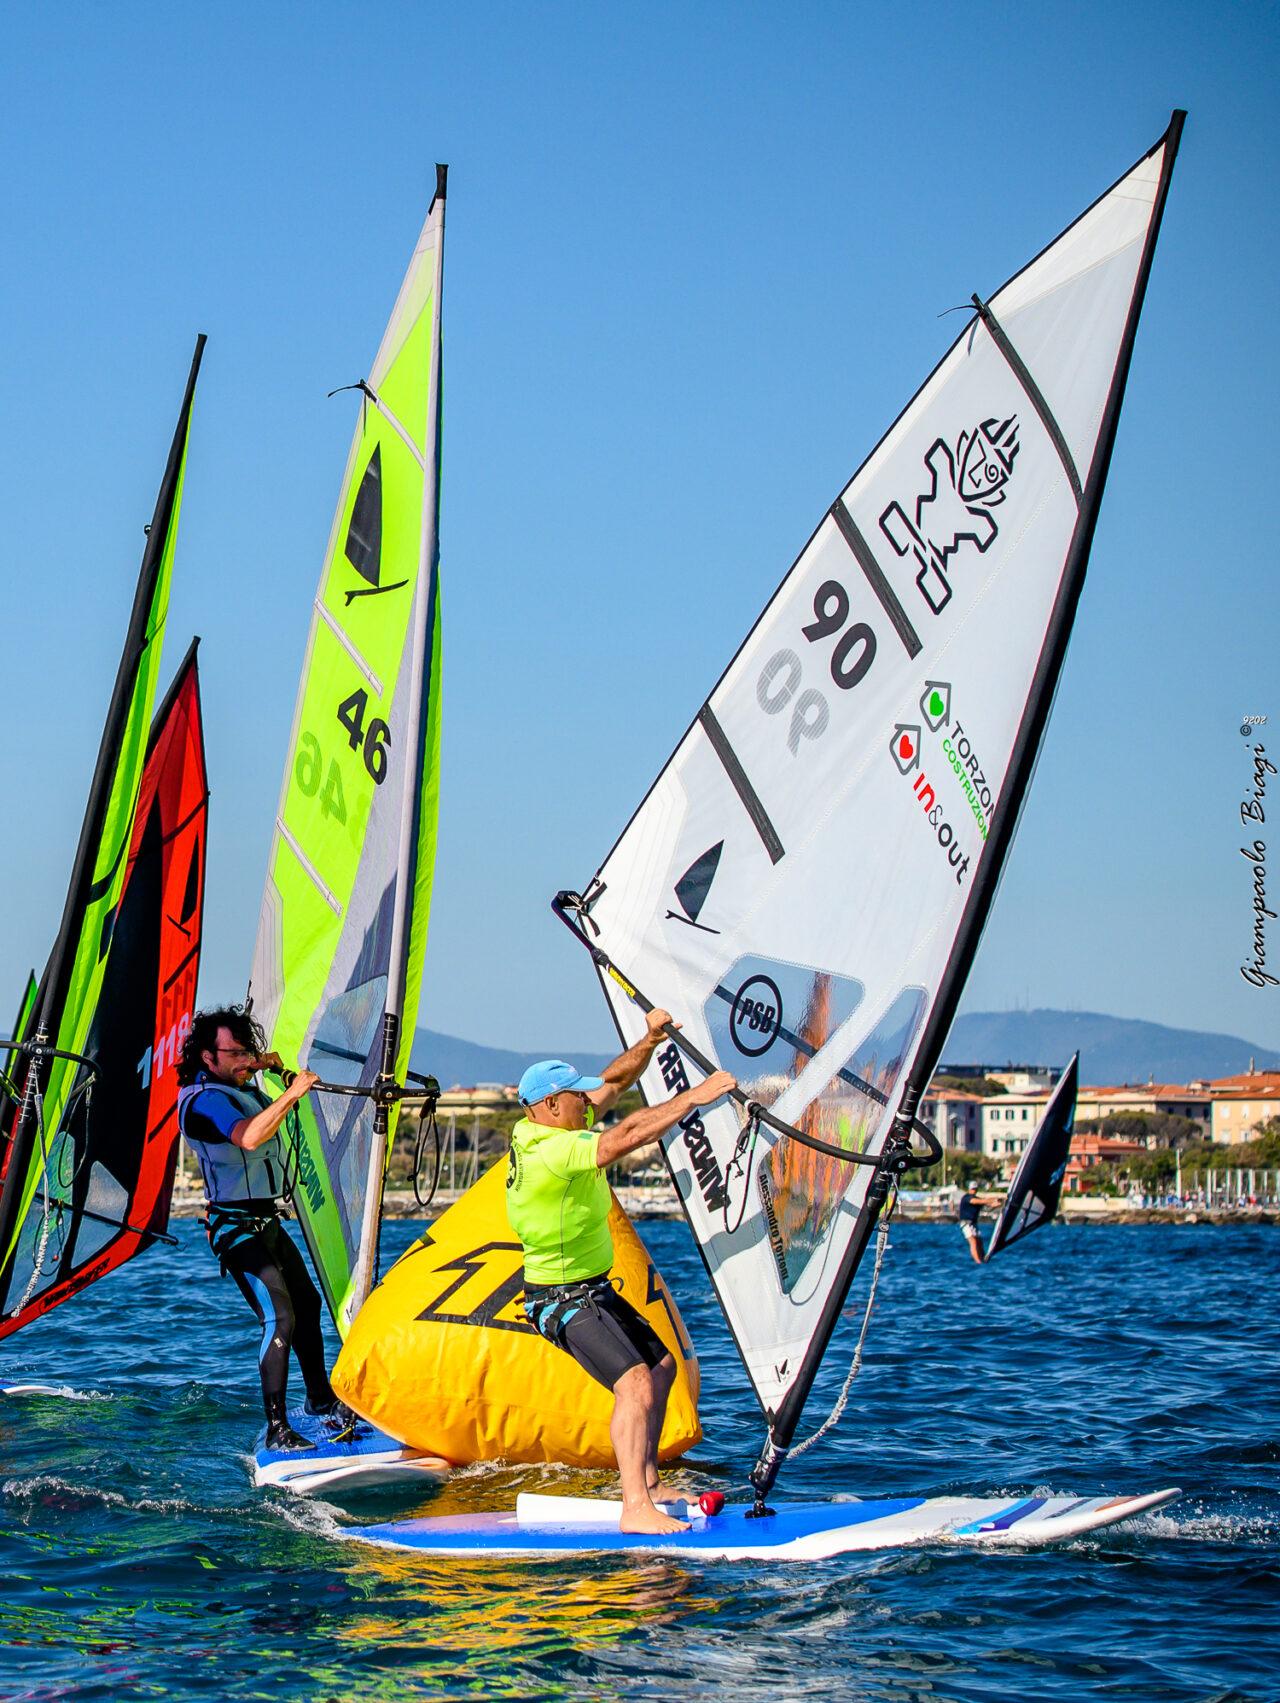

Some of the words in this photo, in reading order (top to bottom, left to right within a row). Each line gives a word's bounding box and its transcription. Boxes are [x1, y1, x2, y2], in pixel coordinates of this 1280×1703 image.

[801, 580, 877, 690] 90
[337, 688, 392, 786] 46
[736, 997, 776, 1034] PSB
[759, 1174, 780, 1238] Alessandro
